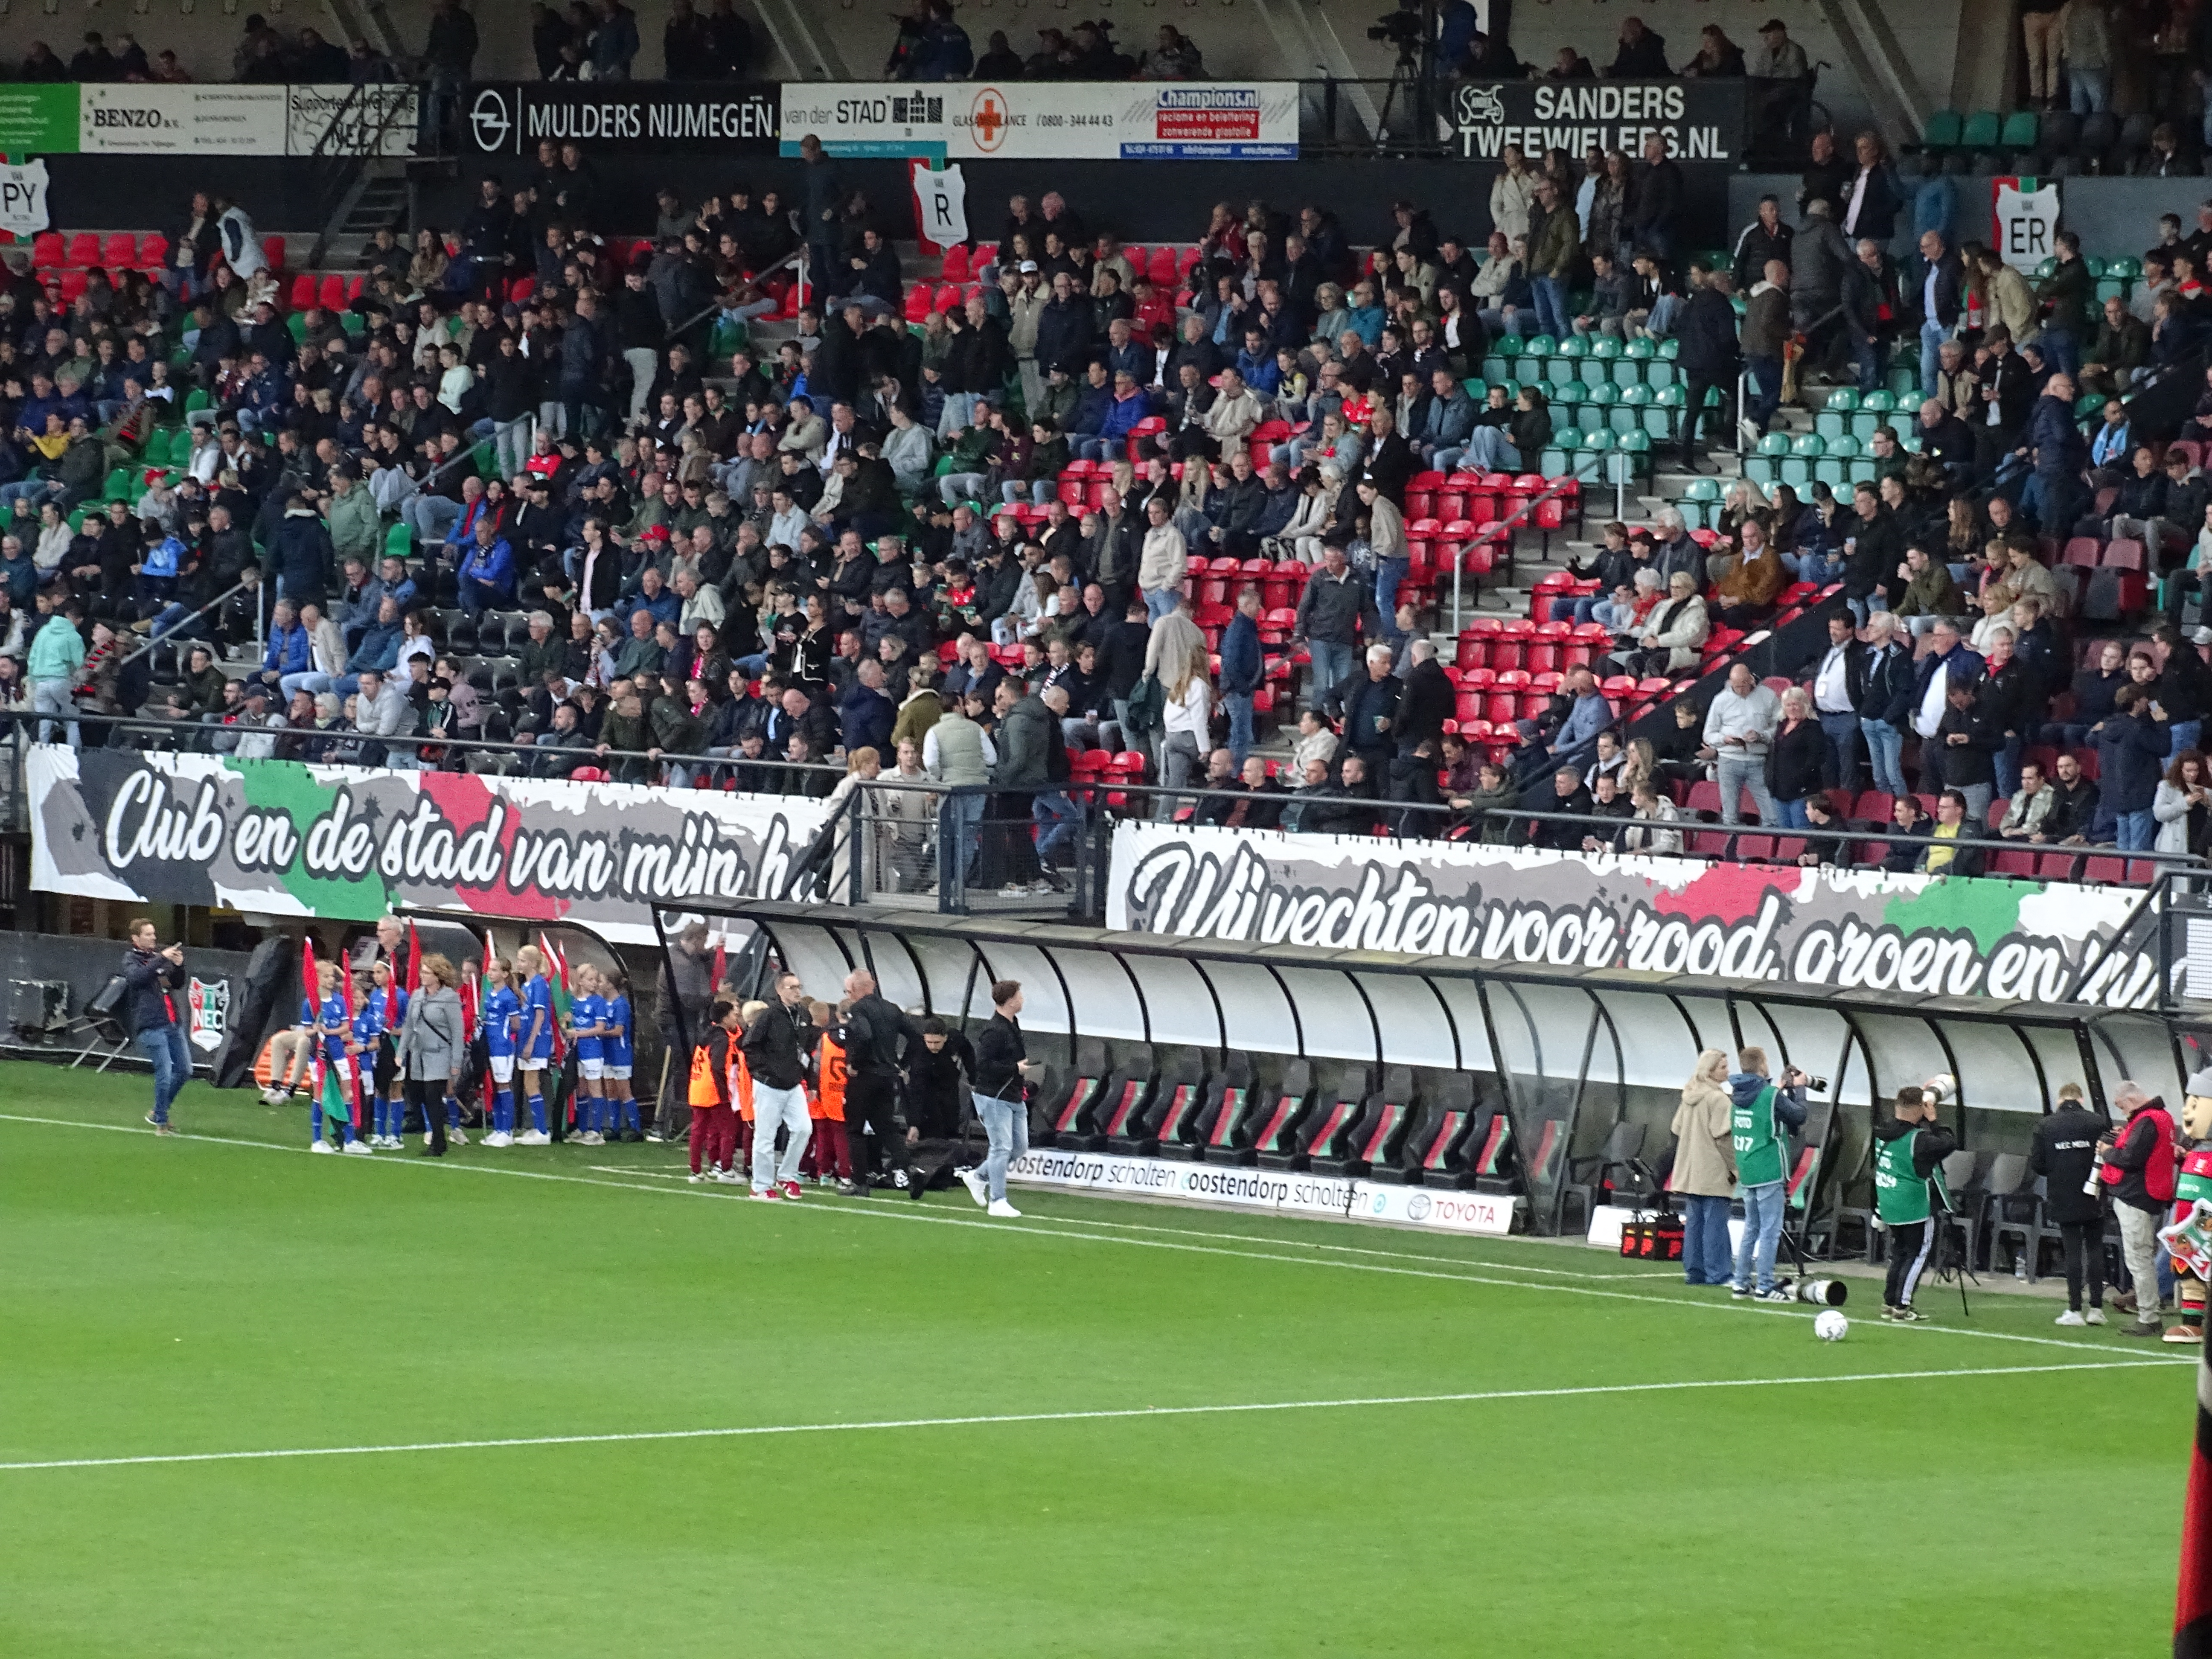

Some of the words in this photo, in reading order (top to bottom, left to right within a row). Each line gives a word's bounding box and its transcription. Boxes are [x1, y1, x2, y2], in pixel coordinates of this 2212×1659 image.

[784, 109, 807, 124] van
[810, 105, 832, 124] der
[837, 99, 886, 124] STAD
[1158, 90, 1258, 108] Champions.nl
[1534, 87, 1685, 120] SANDERS
[93, 109, 162, 128] BENZO
[529, 104, 640, 137] MULDERS
[3, 182, 37, 212] PY
[935, 194, 952, 226] R
[2011, 218, 2046, 254] ER
[106, 769, 223, 868] Club
[236, 813, 297, 865] en
[307, 793, 373, 872] de
[381, 797, 505, 883] stad
[510, 834, 613, 893] van
[623, 816, 746, 930] mijn
[1261, 867, 1479, 957] vechten
[1481, 905, 1617, 967] voor
[1987, 942, 2069, 1001] en
[194, 1009, 223, 1030] NEC
[1007, 1153, 1103, 1182] oostendorp
[1109, 1160, 1176, 1187] scholten
[1189, 1171, 1288, 1208] oostendorp
[1294, 1182, 1367, 1211] scholten
[1436, 1200, 1494, 1224] TOYOTA
